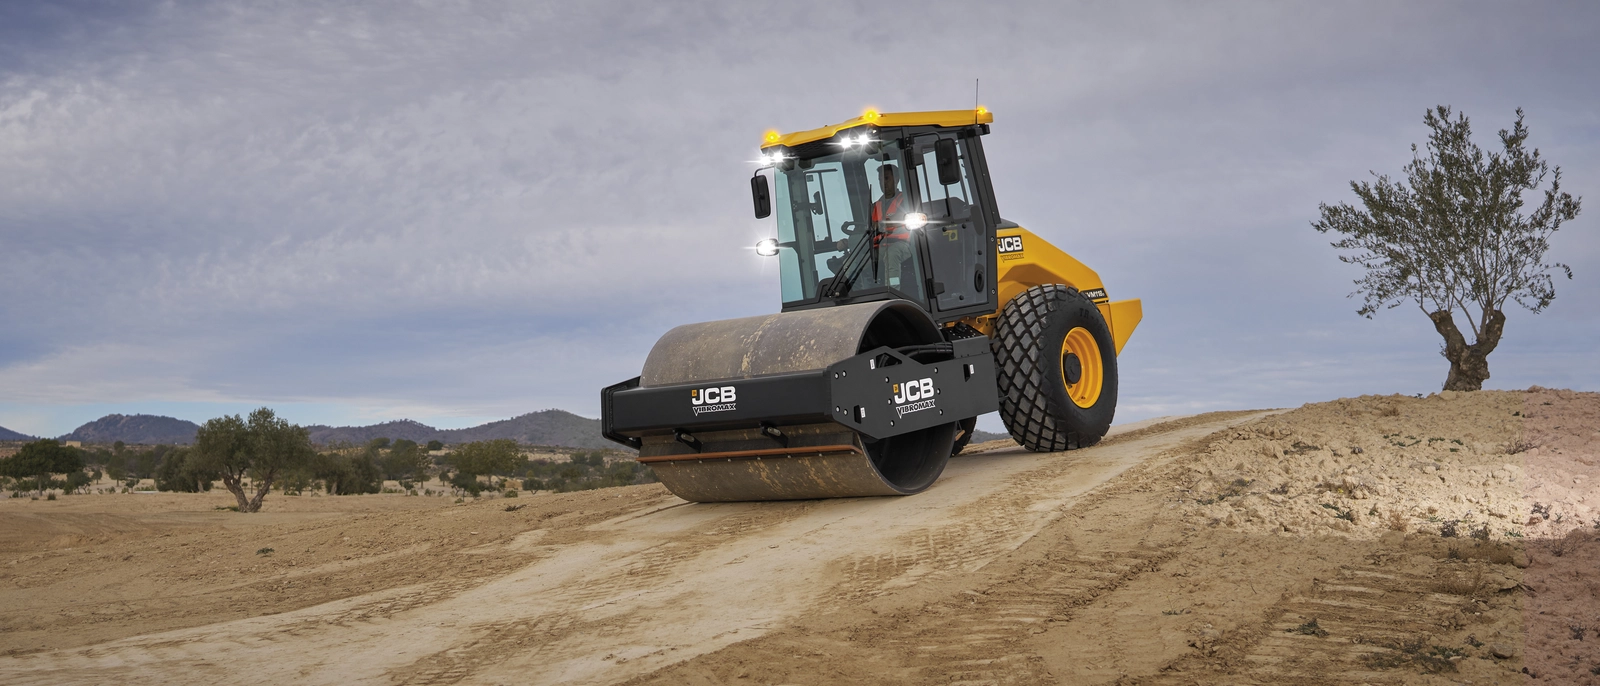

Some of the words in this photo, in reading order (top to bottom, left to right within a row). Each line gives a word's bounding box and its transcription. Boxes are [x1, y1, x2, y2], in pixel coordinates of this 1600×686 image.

[998, 237, 1022, 252] JCB
[692, 386, 736, 405] JCB
[894, 378, 935, 404] JCB
[692, 403, 736, 417] VIBROMAX
[896, 399, 936, 419] VIBROMAX
